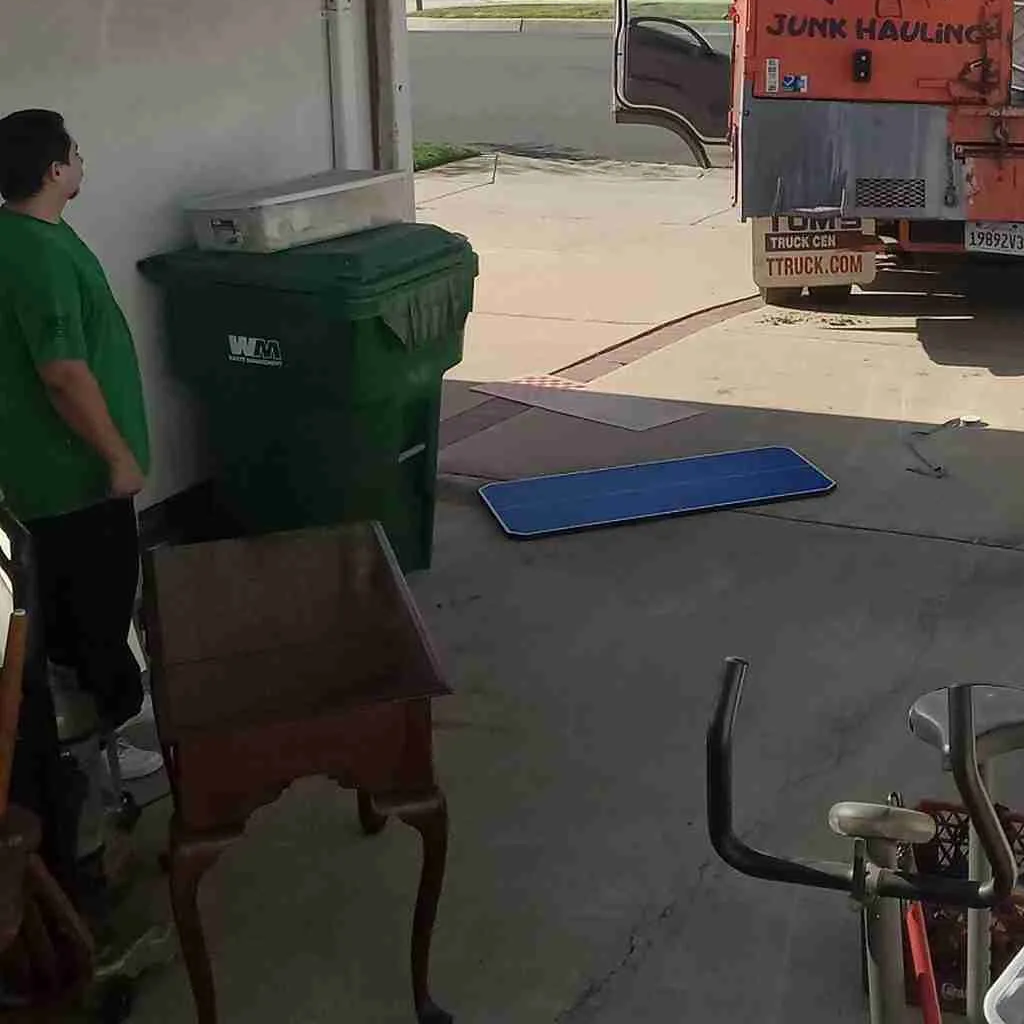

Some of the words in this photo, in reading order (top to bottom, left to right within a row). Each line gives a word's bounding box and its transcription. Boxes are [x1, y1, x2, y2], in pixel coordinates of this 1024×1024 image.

[766, 14, 848, 38] JUNK
[770, 236, 809, 249] TRUCK
[812, 234, 836, 248] CEN
[969, 231, 1024, 250] 19892V3
[766, 254, 863, 276] TTRUCK.COM
[228, 335, 281, 360] WM
